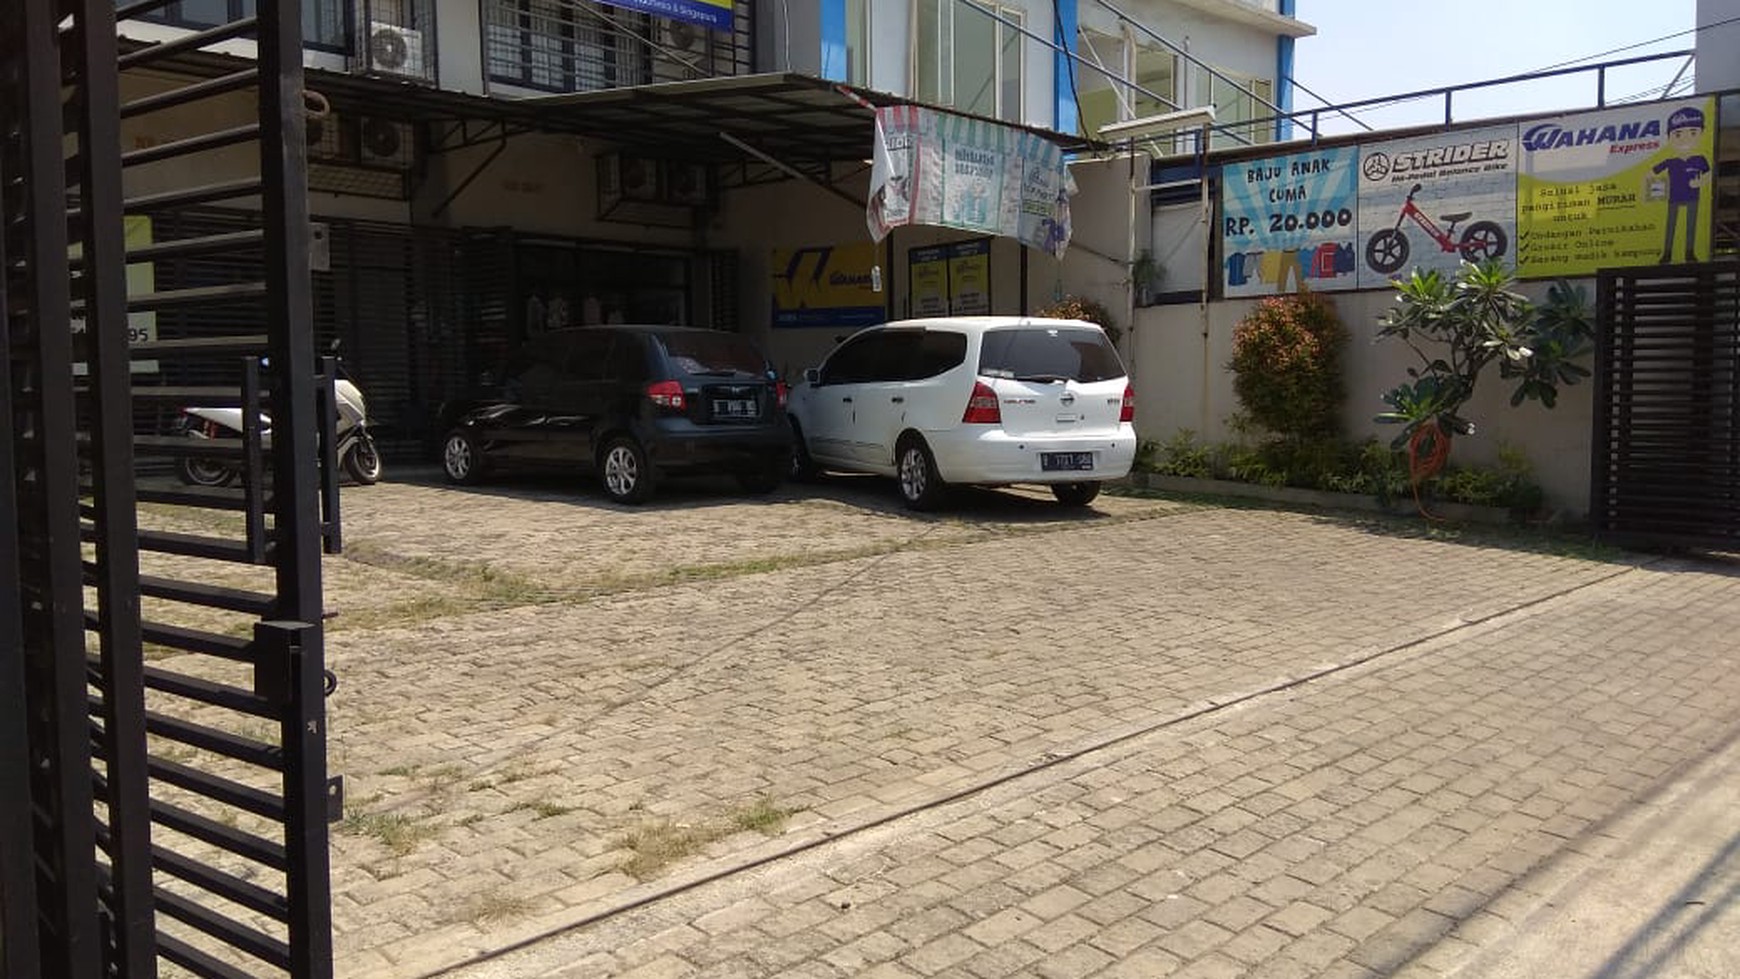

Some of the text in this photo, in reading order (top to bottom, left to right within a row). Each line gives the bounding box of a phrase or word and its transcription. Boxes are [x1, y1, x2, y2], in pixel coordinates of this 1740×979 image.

[1522, 120, 1661, 152] WAHANA
[1392, 139, 1510, 173] STRIDER
[1609, 141, 1661, 154] Express
[1247, 158, 1331, 183] BAJU ANAK
[1269, 185, 1307, 203] CUMA
[1539, 183, 1617, 197] Solusi jasa
[1597, 194, 1636, 206] MURAH
[1226, 208, 1353, 237] RP. 20.000
